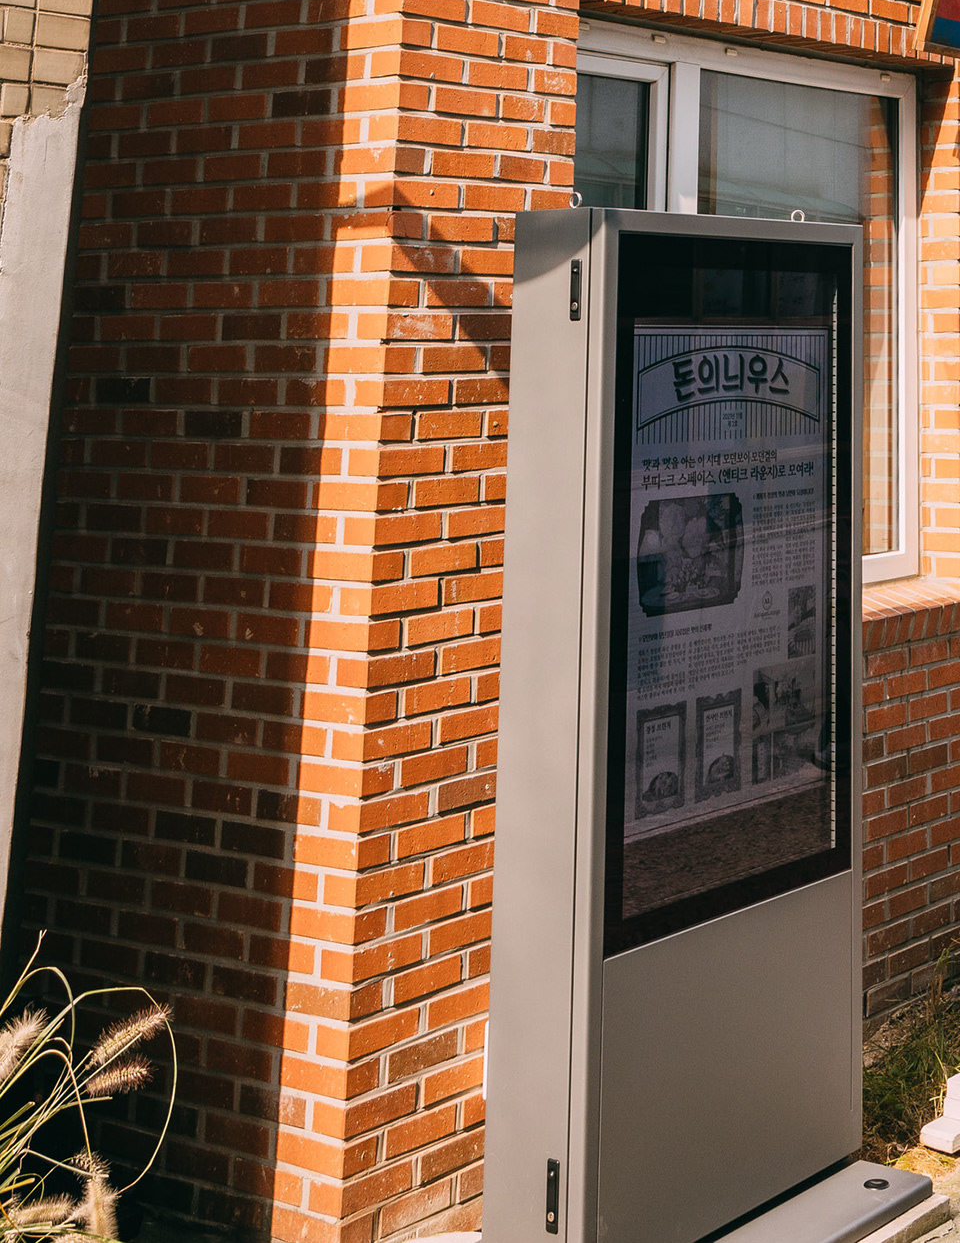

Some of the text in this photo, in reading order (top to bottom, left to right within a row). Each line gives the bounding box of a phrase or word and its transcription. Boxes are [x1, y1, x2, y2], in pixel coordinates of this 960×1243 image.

[680, 454, 696, 469] 아는
[697, 453, 705, 468] 이
[706, 452, 721, 468] 시대
[787, 460, 815, 478] 모여라!
